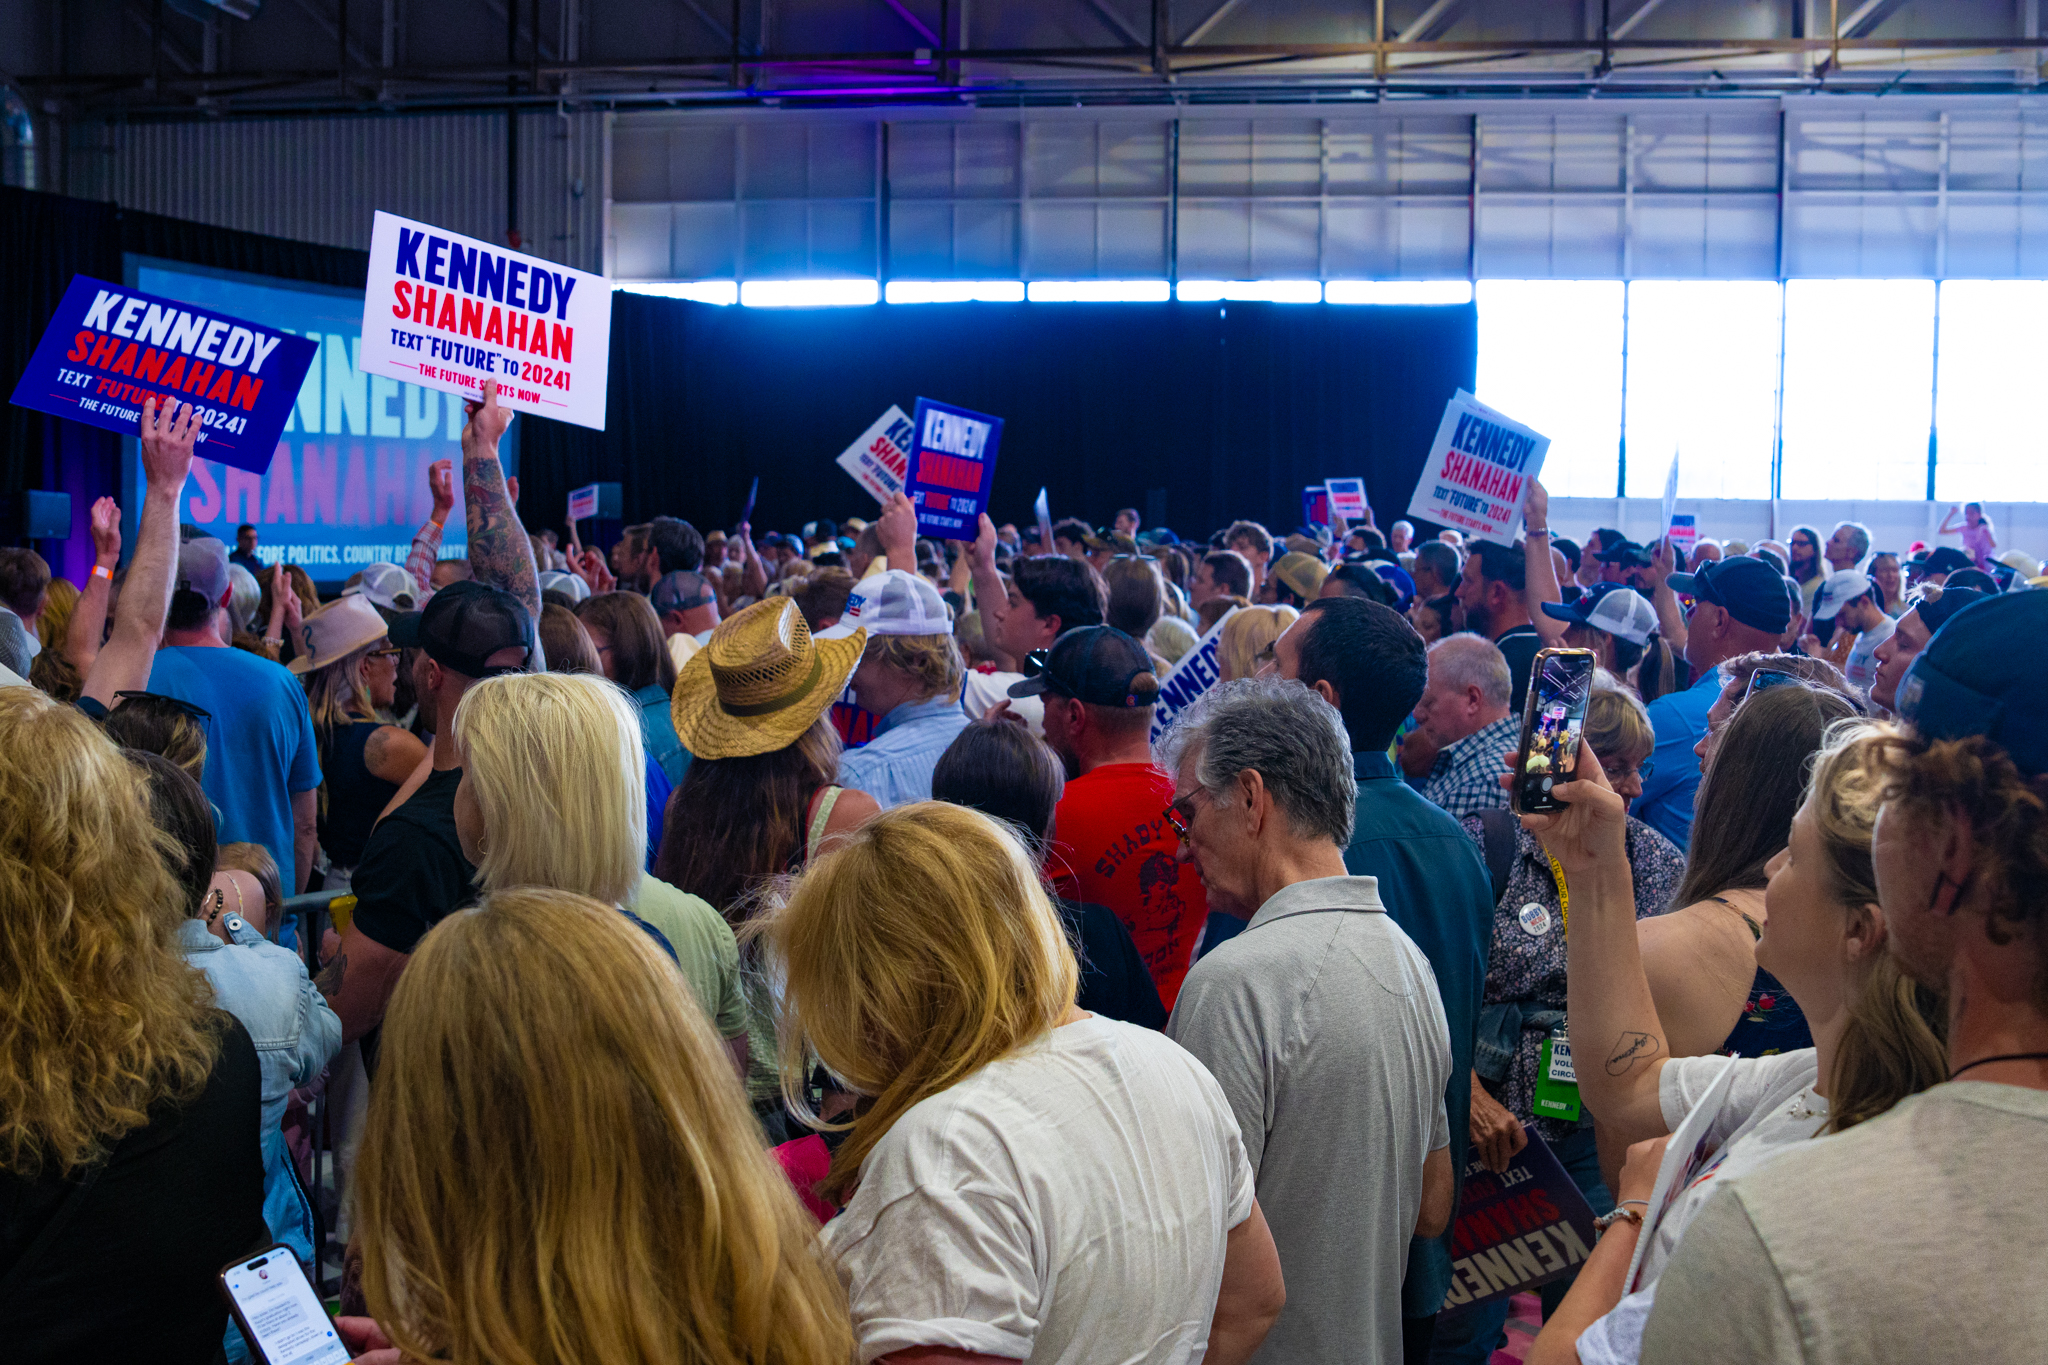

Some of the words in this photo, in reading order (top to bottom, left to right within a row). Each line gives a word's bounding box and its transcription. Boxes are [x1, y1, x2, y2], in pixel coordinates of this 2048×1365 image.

[395, 226, 577, 321] KENNEDY
[82, 289, 281, 374] KENNEDY
[392, 280, 574, 364] SHANAHAN
[67, 330, 264, 412] SHANAHAN
[391, 328, 424, 352] TEXT
[502, 358, 519, 377] TO
[521, 361, 571, 392] 20241
[57, 368, 93, 389] TEXT
[191, 405, 248, 435] 20241
[419, 363, 437, 379] THE
[439, 368, 477, 389] FUTURE
[479, 379, 515, 398] SRTS
[517, 388, 541, 404] NOW
[78, 397, 99, 413] THE
[99, 402, 141, 423] FUTURE
[921, 408, 992, 461] KENNEDY
[1451, 412, 1537, 473] KENNEDY
[870, 437, 906, 480] SHAN
[916, 451, 984, 493] SHANAHAN
[1440, 450, 1523, 504] SHANAHAN
[1433, 485, 1450, 501] TEXT
[1480, 502, 1489, 515] TO
[1487, 503, 1512, 525] 20241
[344, 544, 394, 564] COUNTRY
[438, 544, 468, 560] ARTY
[1095, 819, 1163, 879] SHADY
[1557, 876, 1568, 899] YOUR
[1521, 906, 1544, 924] BOBBY
[1530, 913, 1547, 927] NICOLE
[1533, 921, 1547, 933] 2024
[1554, 1043, 1571, 1056] KEN
[1551, 1069, 1576, 1078] CIRCU
[1500, 1166, 1534, 1188] TEXT
[1444, 1220, 1591, 1309] KENNED
